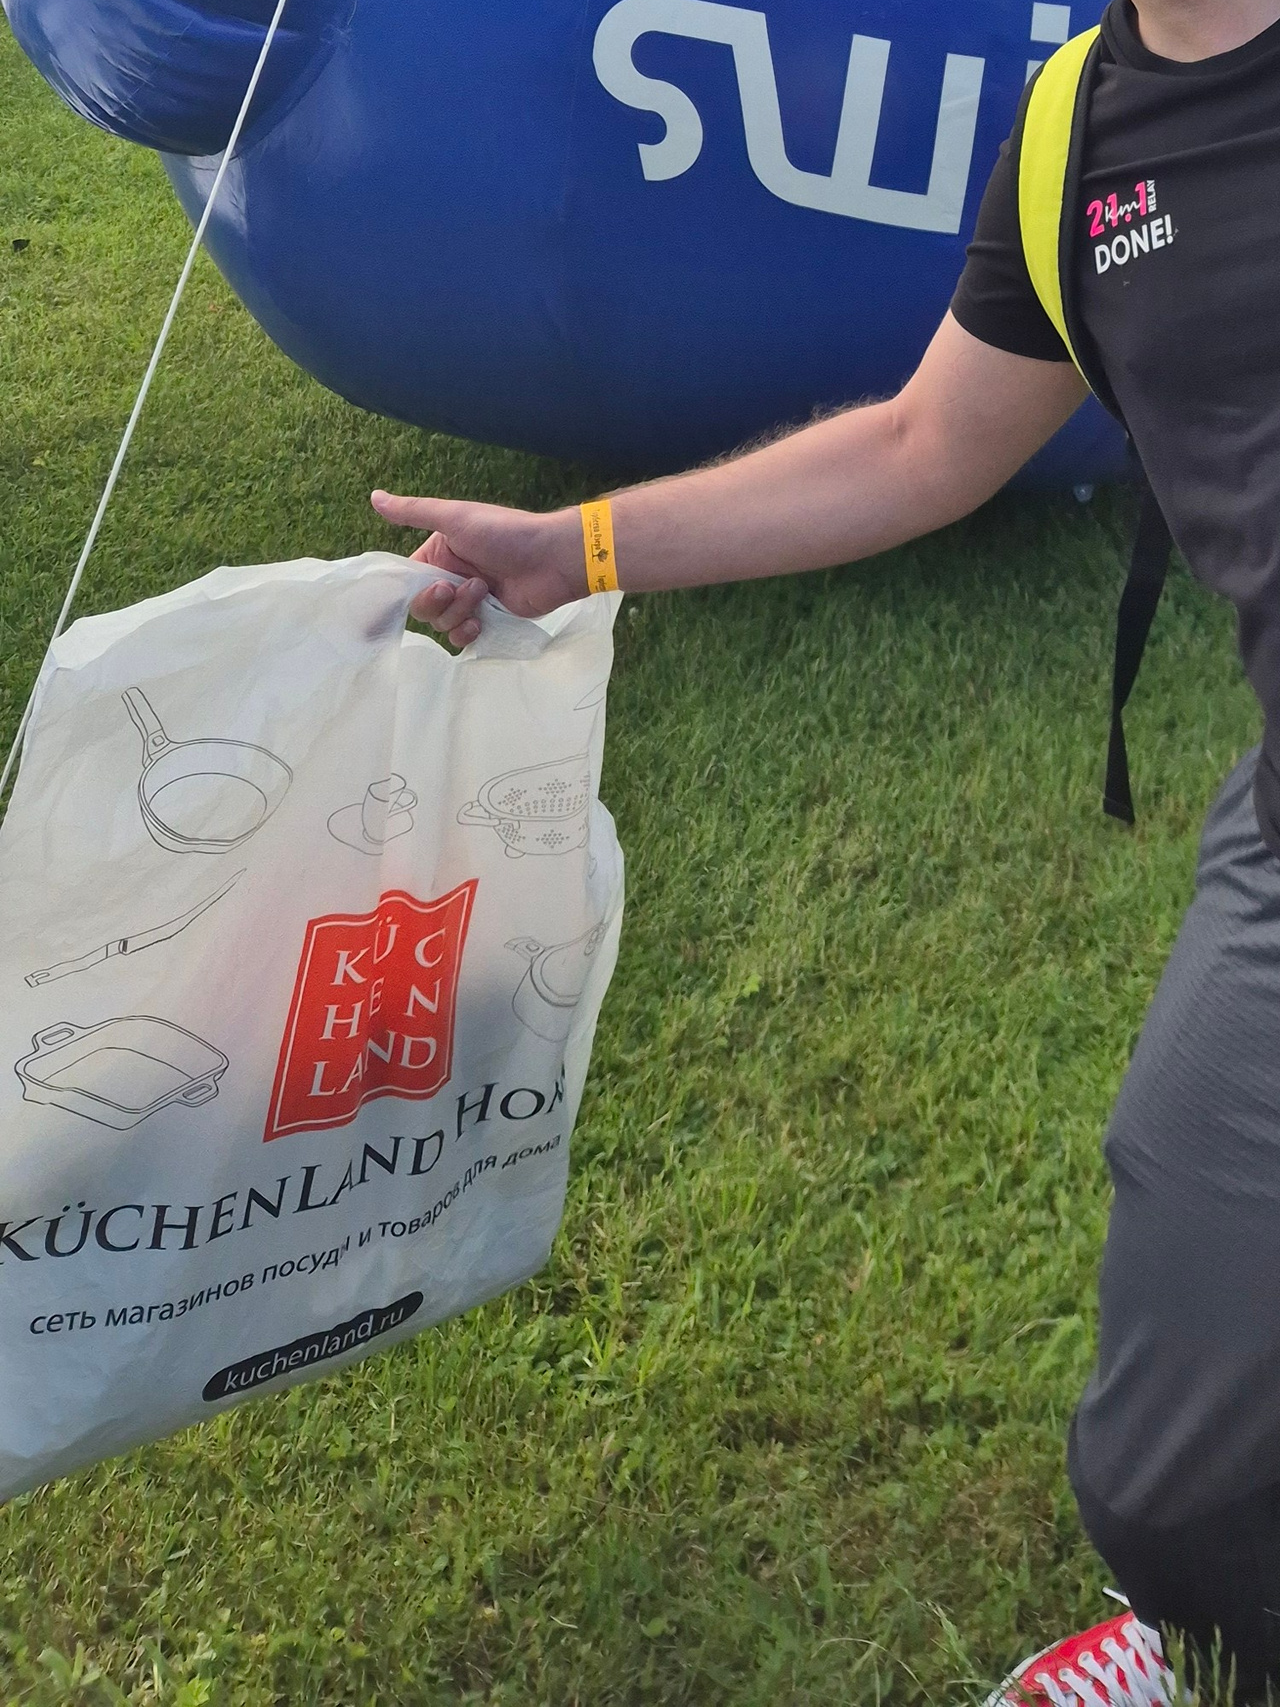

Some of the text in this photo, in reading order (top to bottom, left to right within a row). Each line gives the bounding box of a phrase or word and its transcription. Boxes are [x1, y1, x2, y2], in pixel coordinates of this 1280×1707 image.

[1146, 179, 1157, 214] RELAY
[1094, 213, 1174, 275] DONE!
[306, 1029, 437, 1098] LAND
[0, 1129, 445, 1265] KÜCHENLAND
[29, 1311, 97, 1335] сеть
[104, 1273, 255, 1328] магазинов
[358, 1227, 372, 1248] и
[378, 1180, 461, 1239] товаров
[462, 1154, 497, 1193] для
[501, 1133, 562, 1170] дома
[223, 1306, 404, 1393] kuchenland.ru
